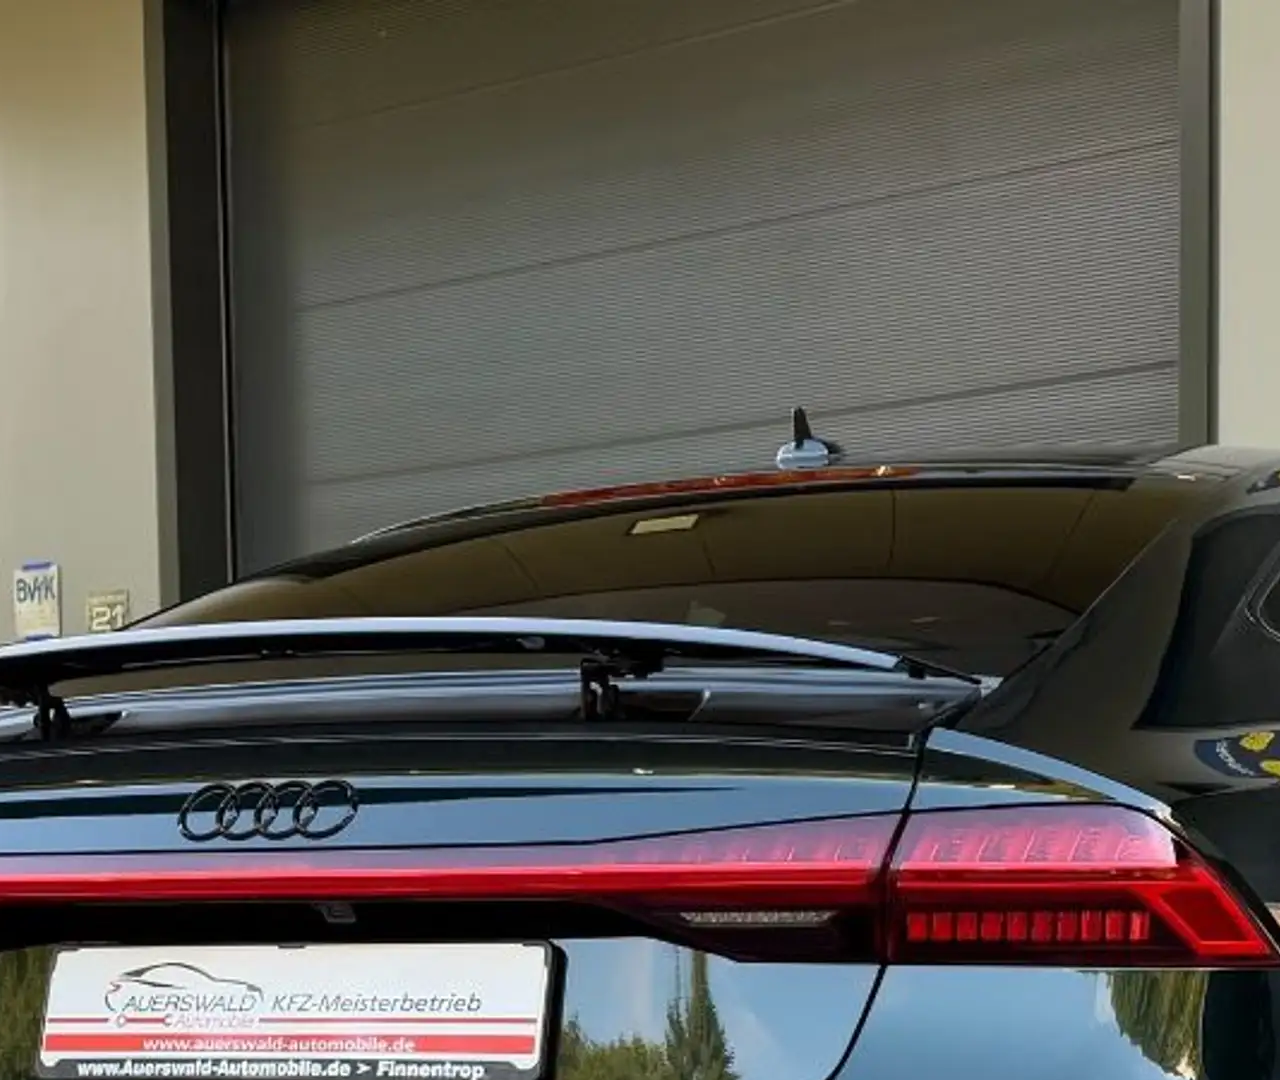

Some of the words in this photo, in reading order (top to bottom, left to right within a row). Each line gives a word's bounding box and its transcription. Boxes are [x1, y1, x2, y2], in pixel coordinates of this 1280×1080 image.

[90, 604, 125, 631] 21
[122, 994, 258, 1013] AUERSWALD
[271, 992, 483, 1013] KFZ-Meisterbetrieb
[142, 1036, 417, 1053] www.auerswald-automobile.de
[76, 1058, 352, 1078] www.Auerswald-Automobile.de
